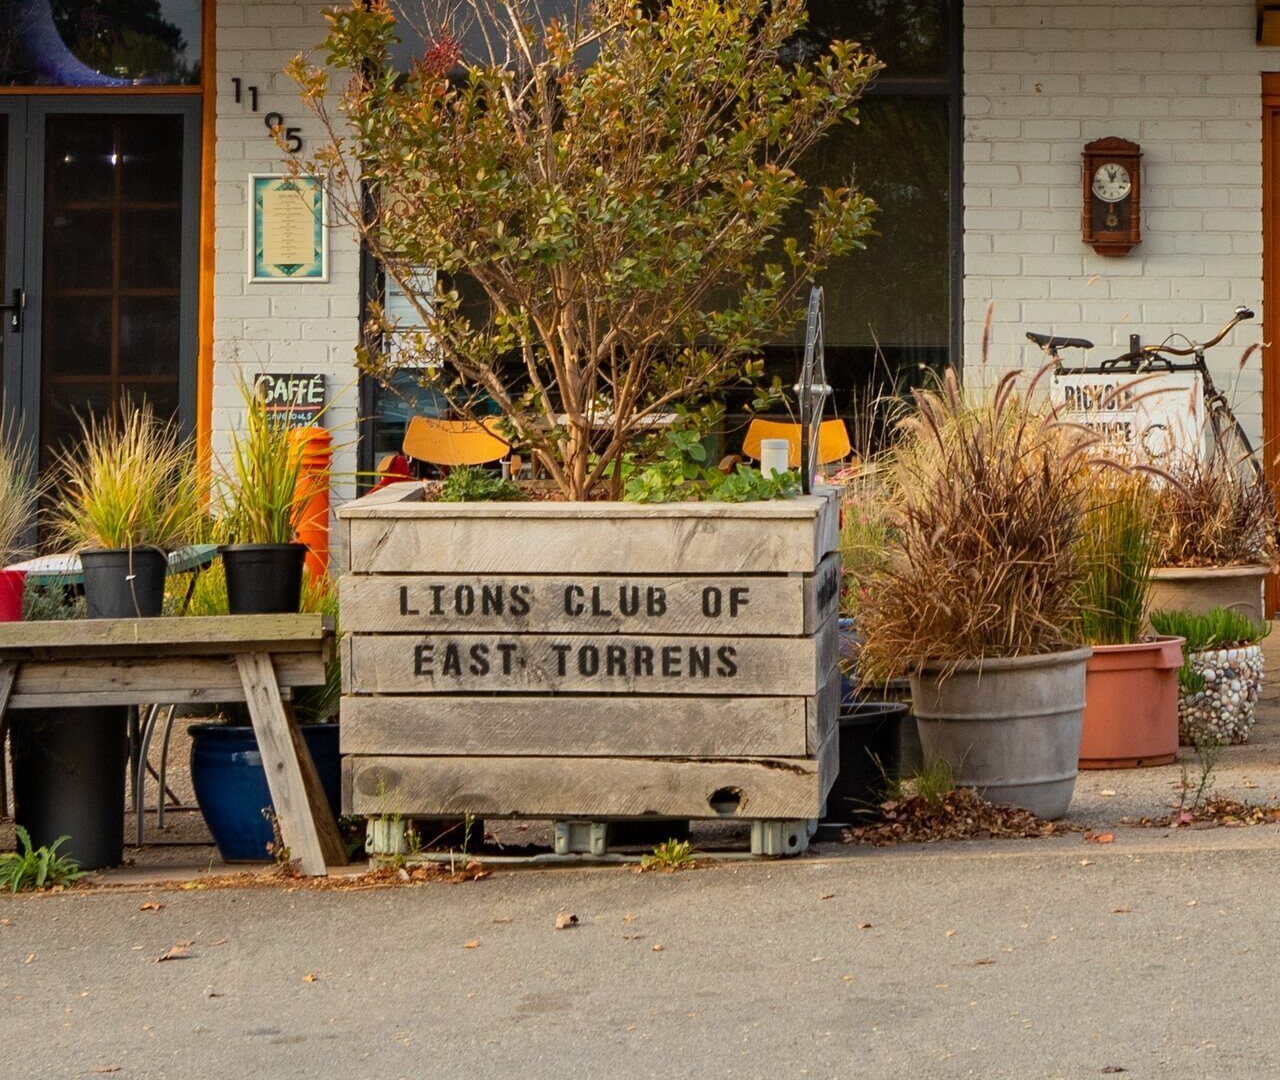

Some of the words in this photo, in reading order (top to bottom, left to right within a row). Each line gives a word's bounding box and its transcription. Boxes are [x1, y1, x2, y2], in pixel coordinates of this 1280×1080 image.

[400, 585, 531, 617] LIONS
[564, 585, 668, 618] CLUB
[702, 586, 750, 618] OF
[414, 644, 517, 677] EAST
[552, 645, 738, 678] TORRENS
